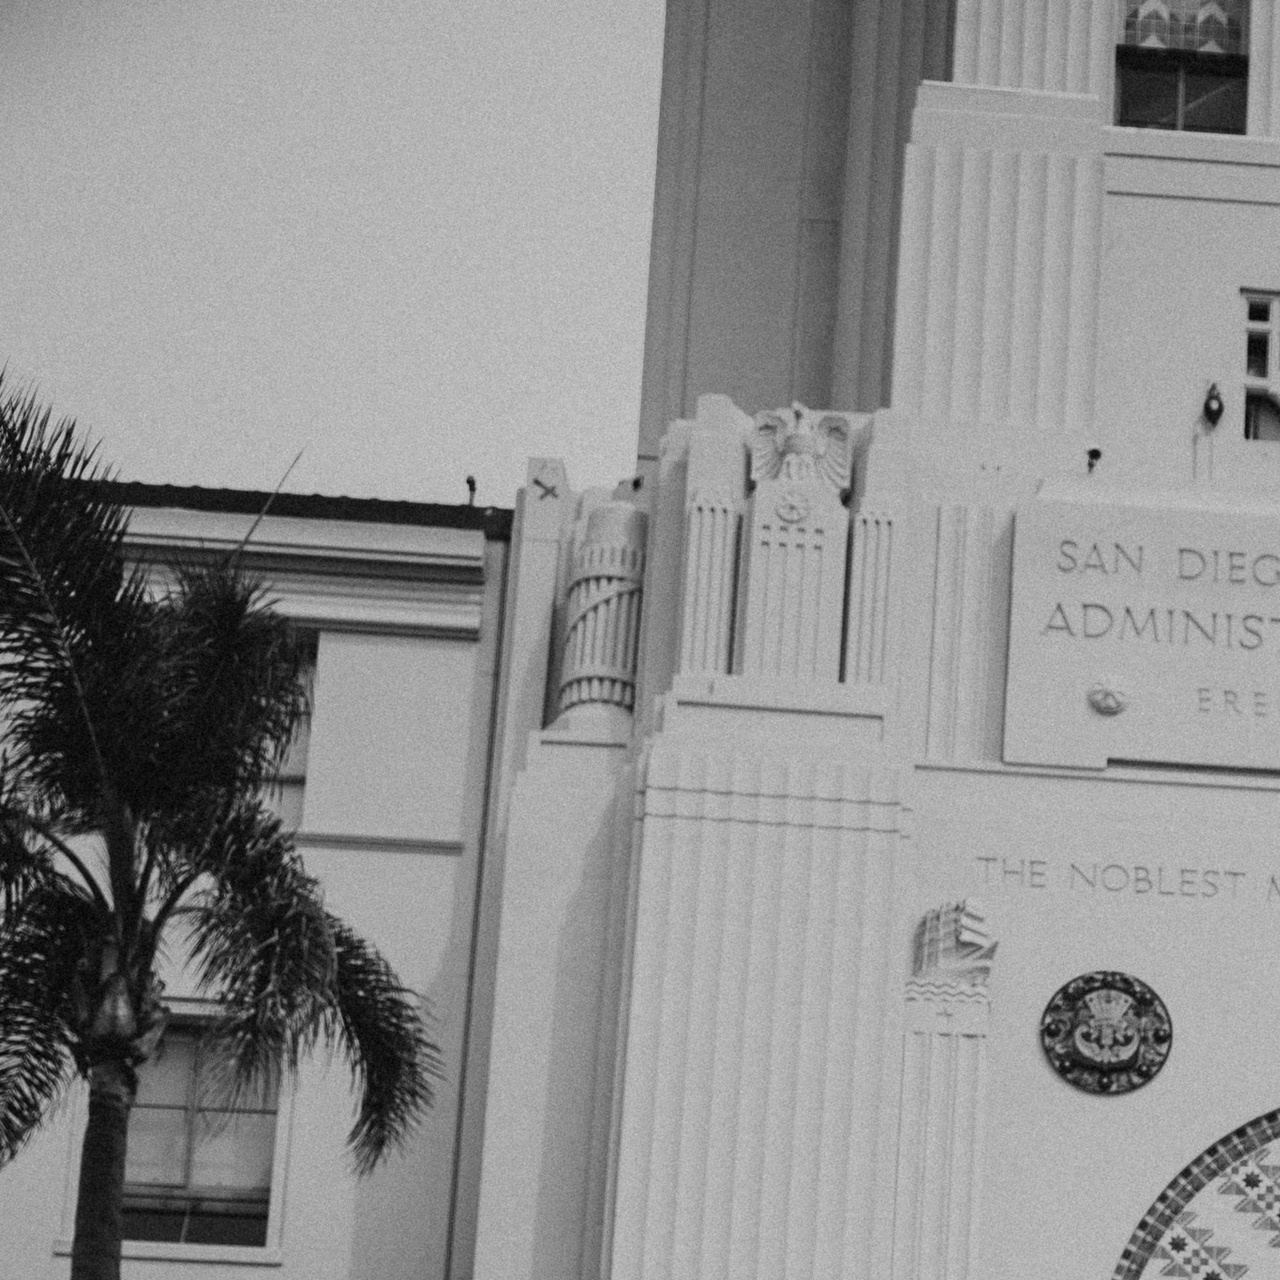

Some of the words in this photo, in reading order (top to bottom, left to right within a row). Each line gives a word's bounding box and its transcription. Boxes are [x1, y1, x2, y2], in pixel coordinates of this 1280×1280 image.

[1056, 539, 1145, 576] SAN
[977, 855, 1046, 889] THE
[1069, 863, 1247, 899] NOBLEST
